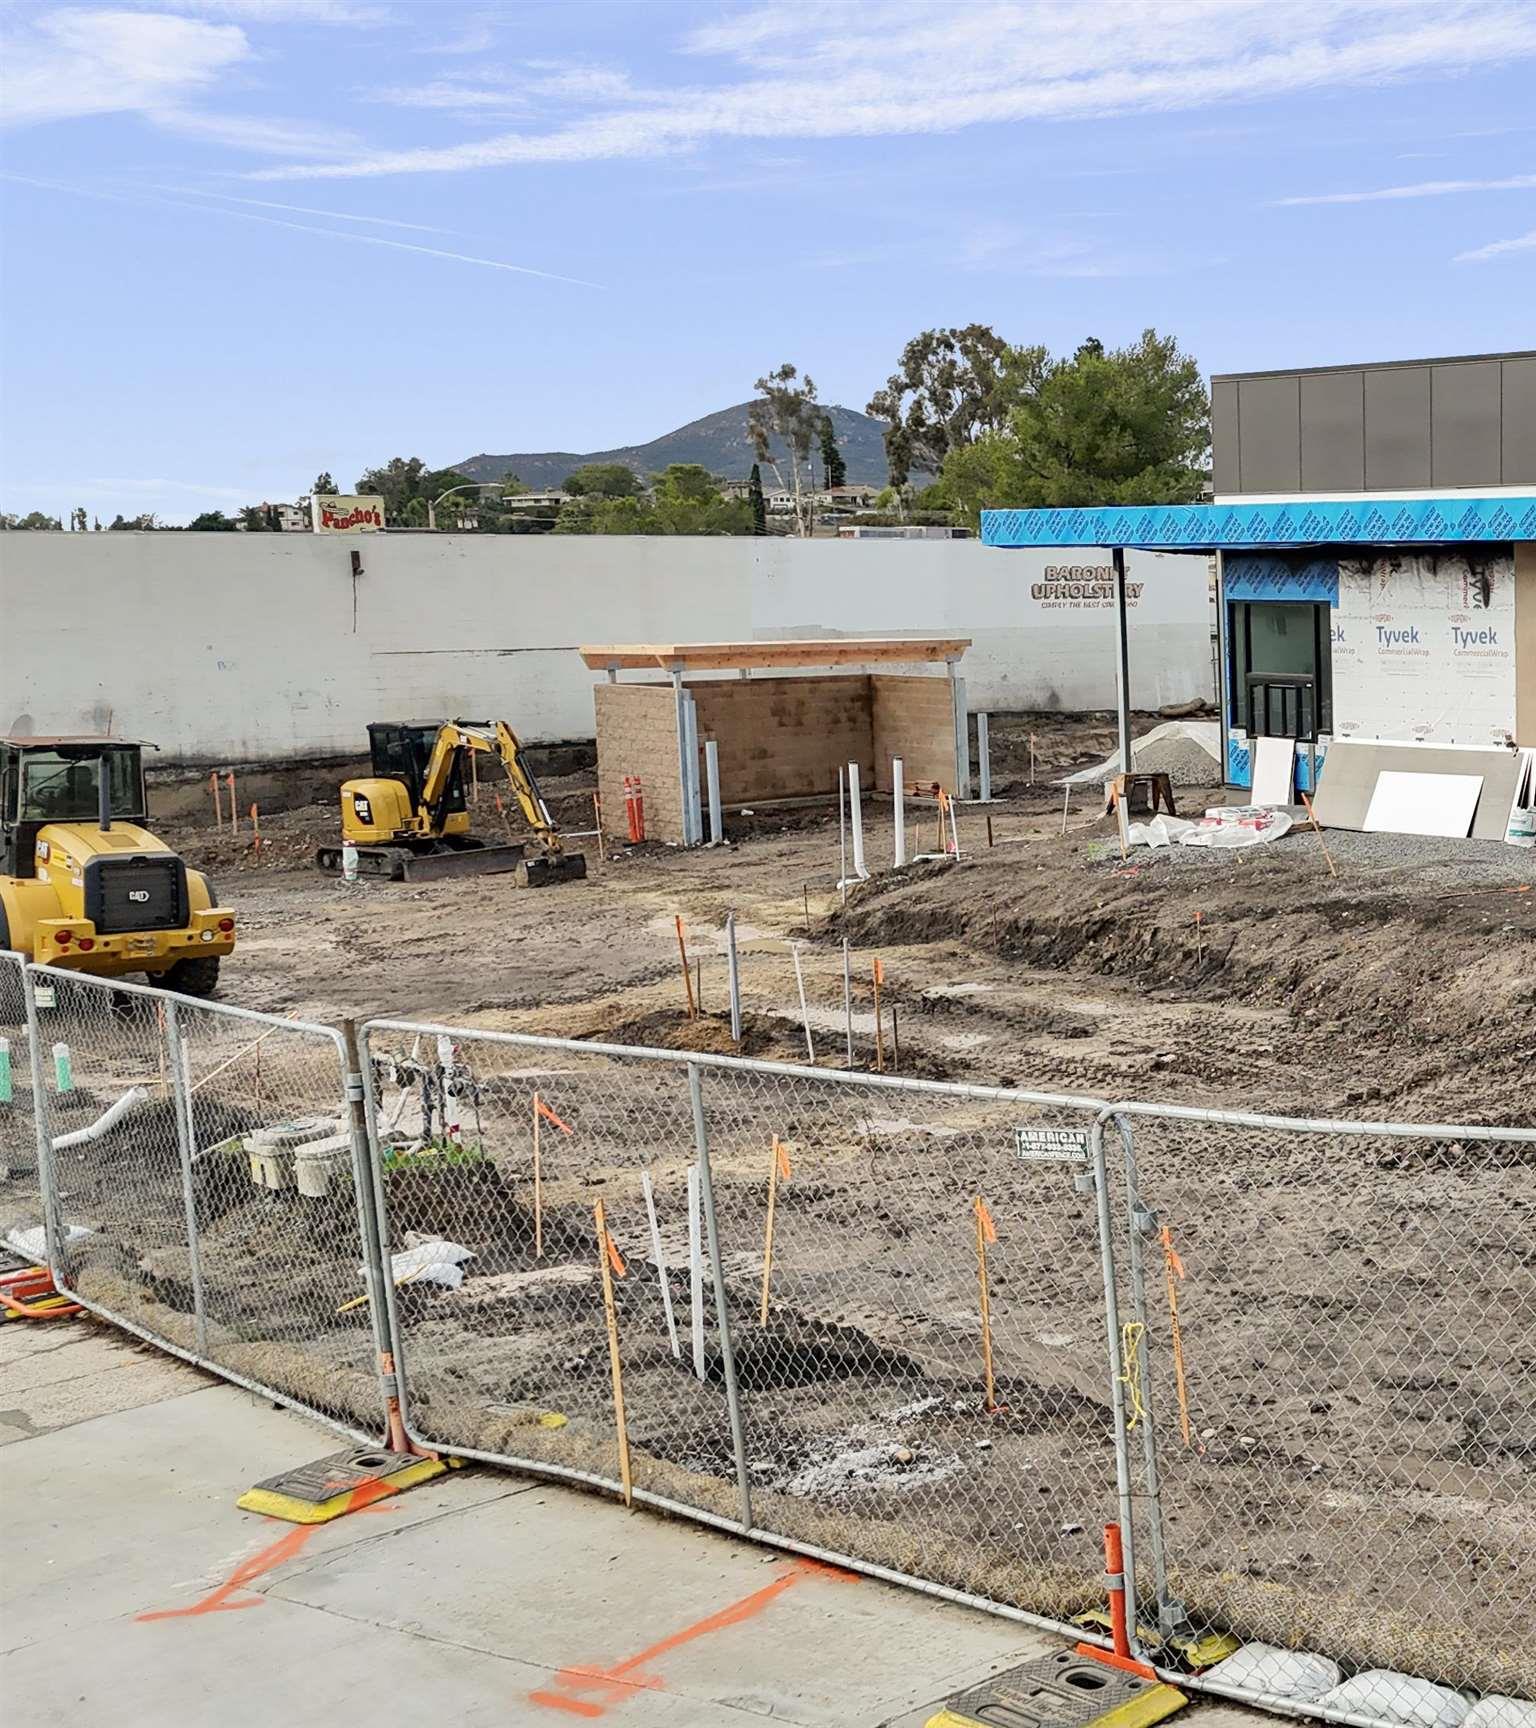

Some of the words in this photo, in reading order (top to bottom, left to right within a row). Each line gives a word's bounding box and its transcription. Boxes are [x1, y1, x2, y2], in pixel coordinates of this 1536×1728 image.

[322, 504, 381, 529] Pancho's
[1031, 583, 1144, 600] UPHOLSTRY
[1376, 625, 1419, 648] Tyvek
[1451, 626, 1498, 649] Tyvek
[1020, 1131, 1085, 1144] AMERICAN
